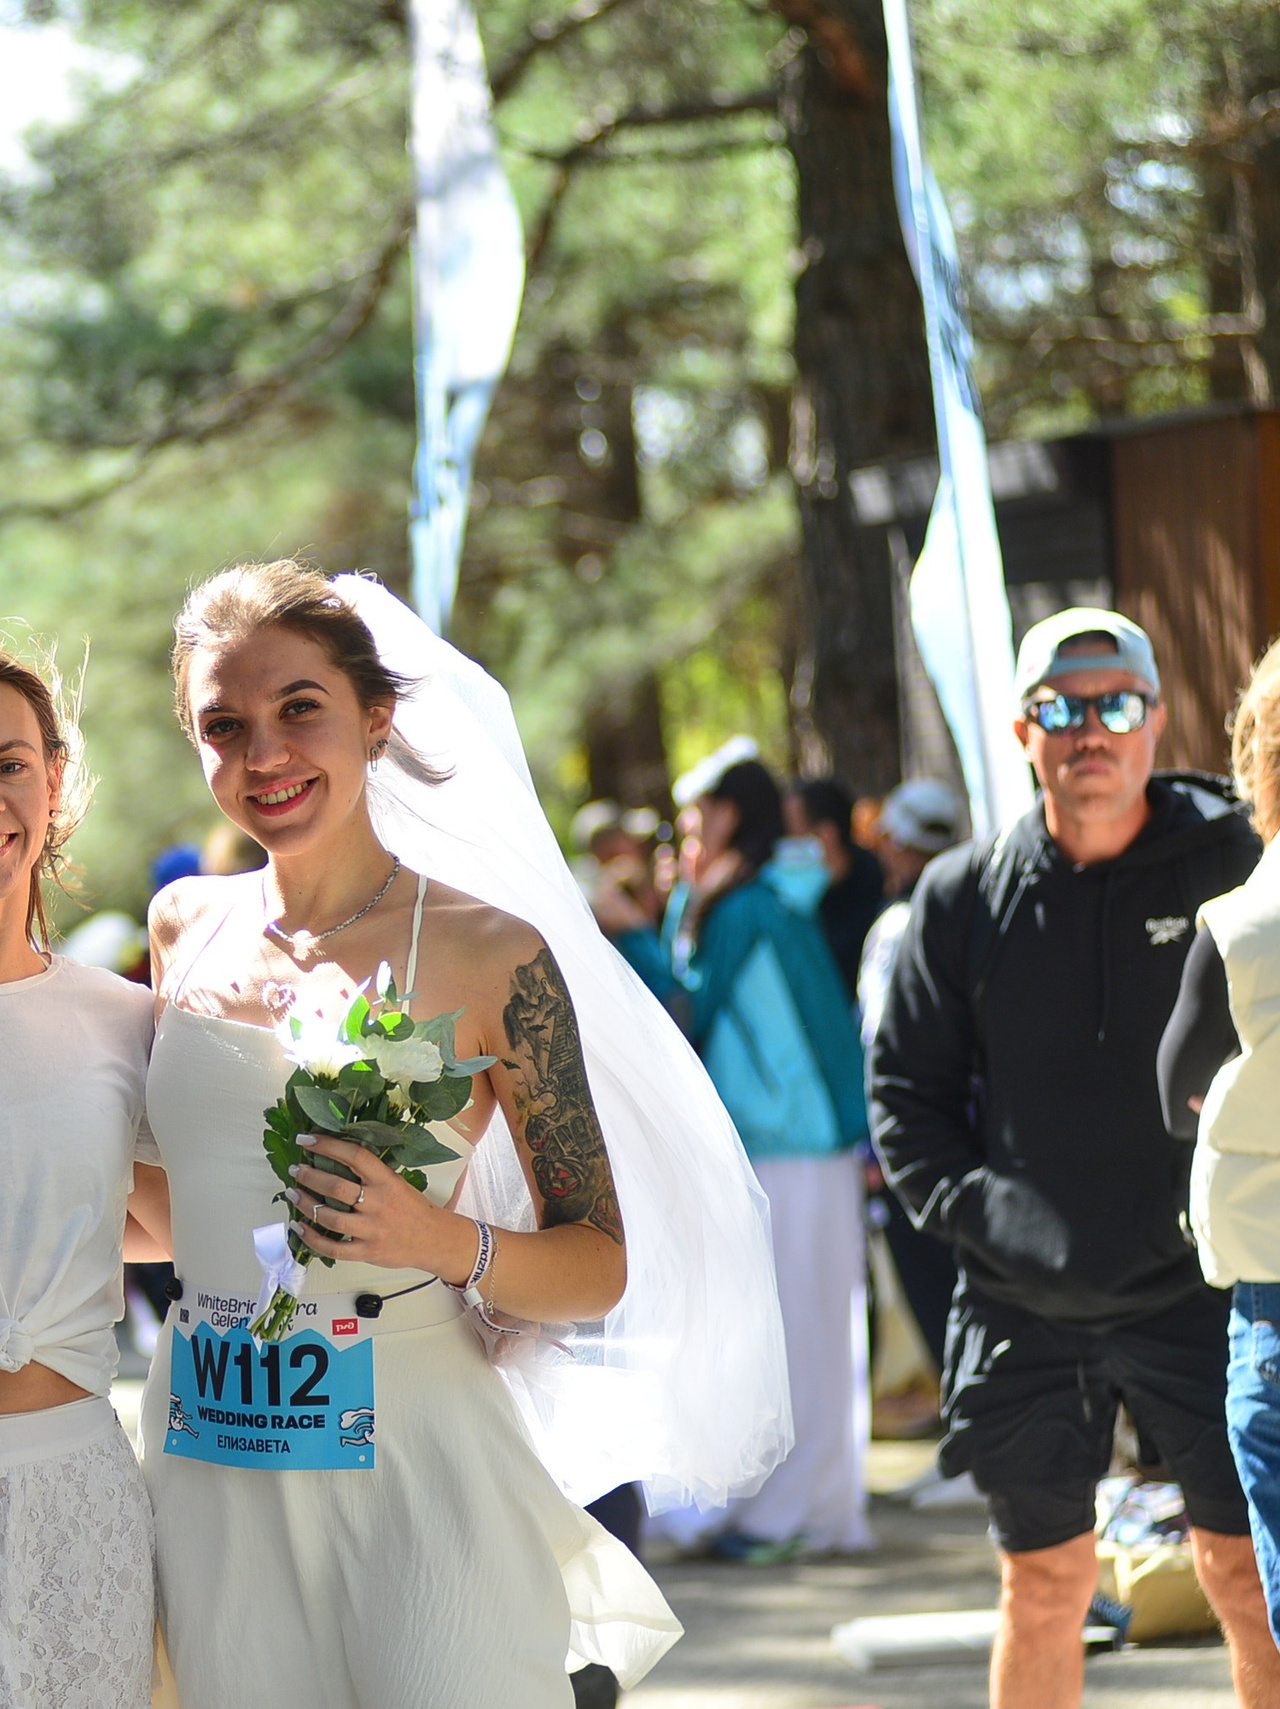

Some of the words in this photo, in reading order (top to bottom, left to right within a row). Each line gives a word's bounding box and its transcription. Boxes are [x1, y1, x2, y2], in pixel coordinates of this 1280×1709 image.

[191, 1334, 330, 1407] W112
[197, 1405, 268, 1429] WEDDING
[271, 1414, 326, 1430] RACE
[217, 1434, 291, 1454] ЕЛИЗАВЕТА
